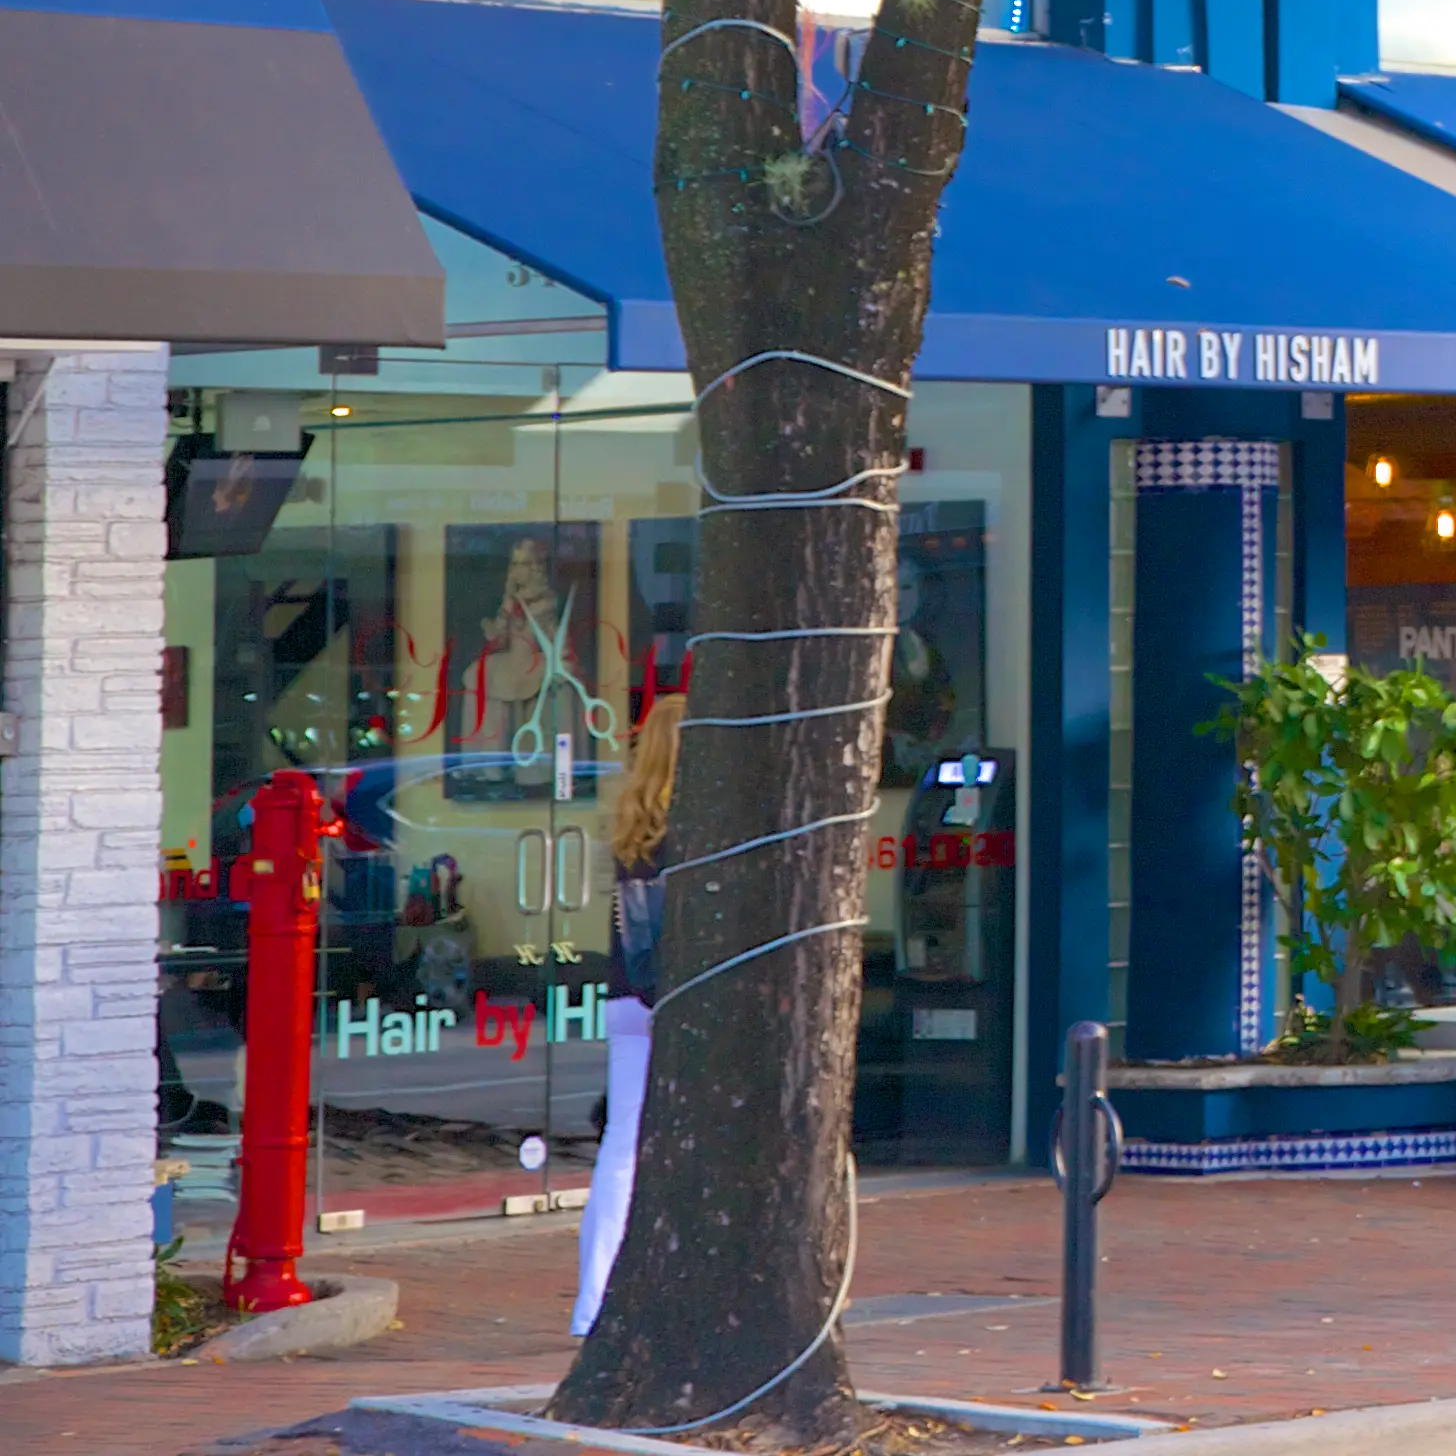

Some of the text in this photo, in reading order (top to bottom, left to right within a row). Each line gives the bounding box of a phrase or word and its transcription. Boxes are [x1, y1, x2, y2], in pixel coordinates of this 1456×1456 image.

[1108, 328, 1379, 384] HAIR BY HISHAM
[337, 982, 608, 1062] Hair by Hi
